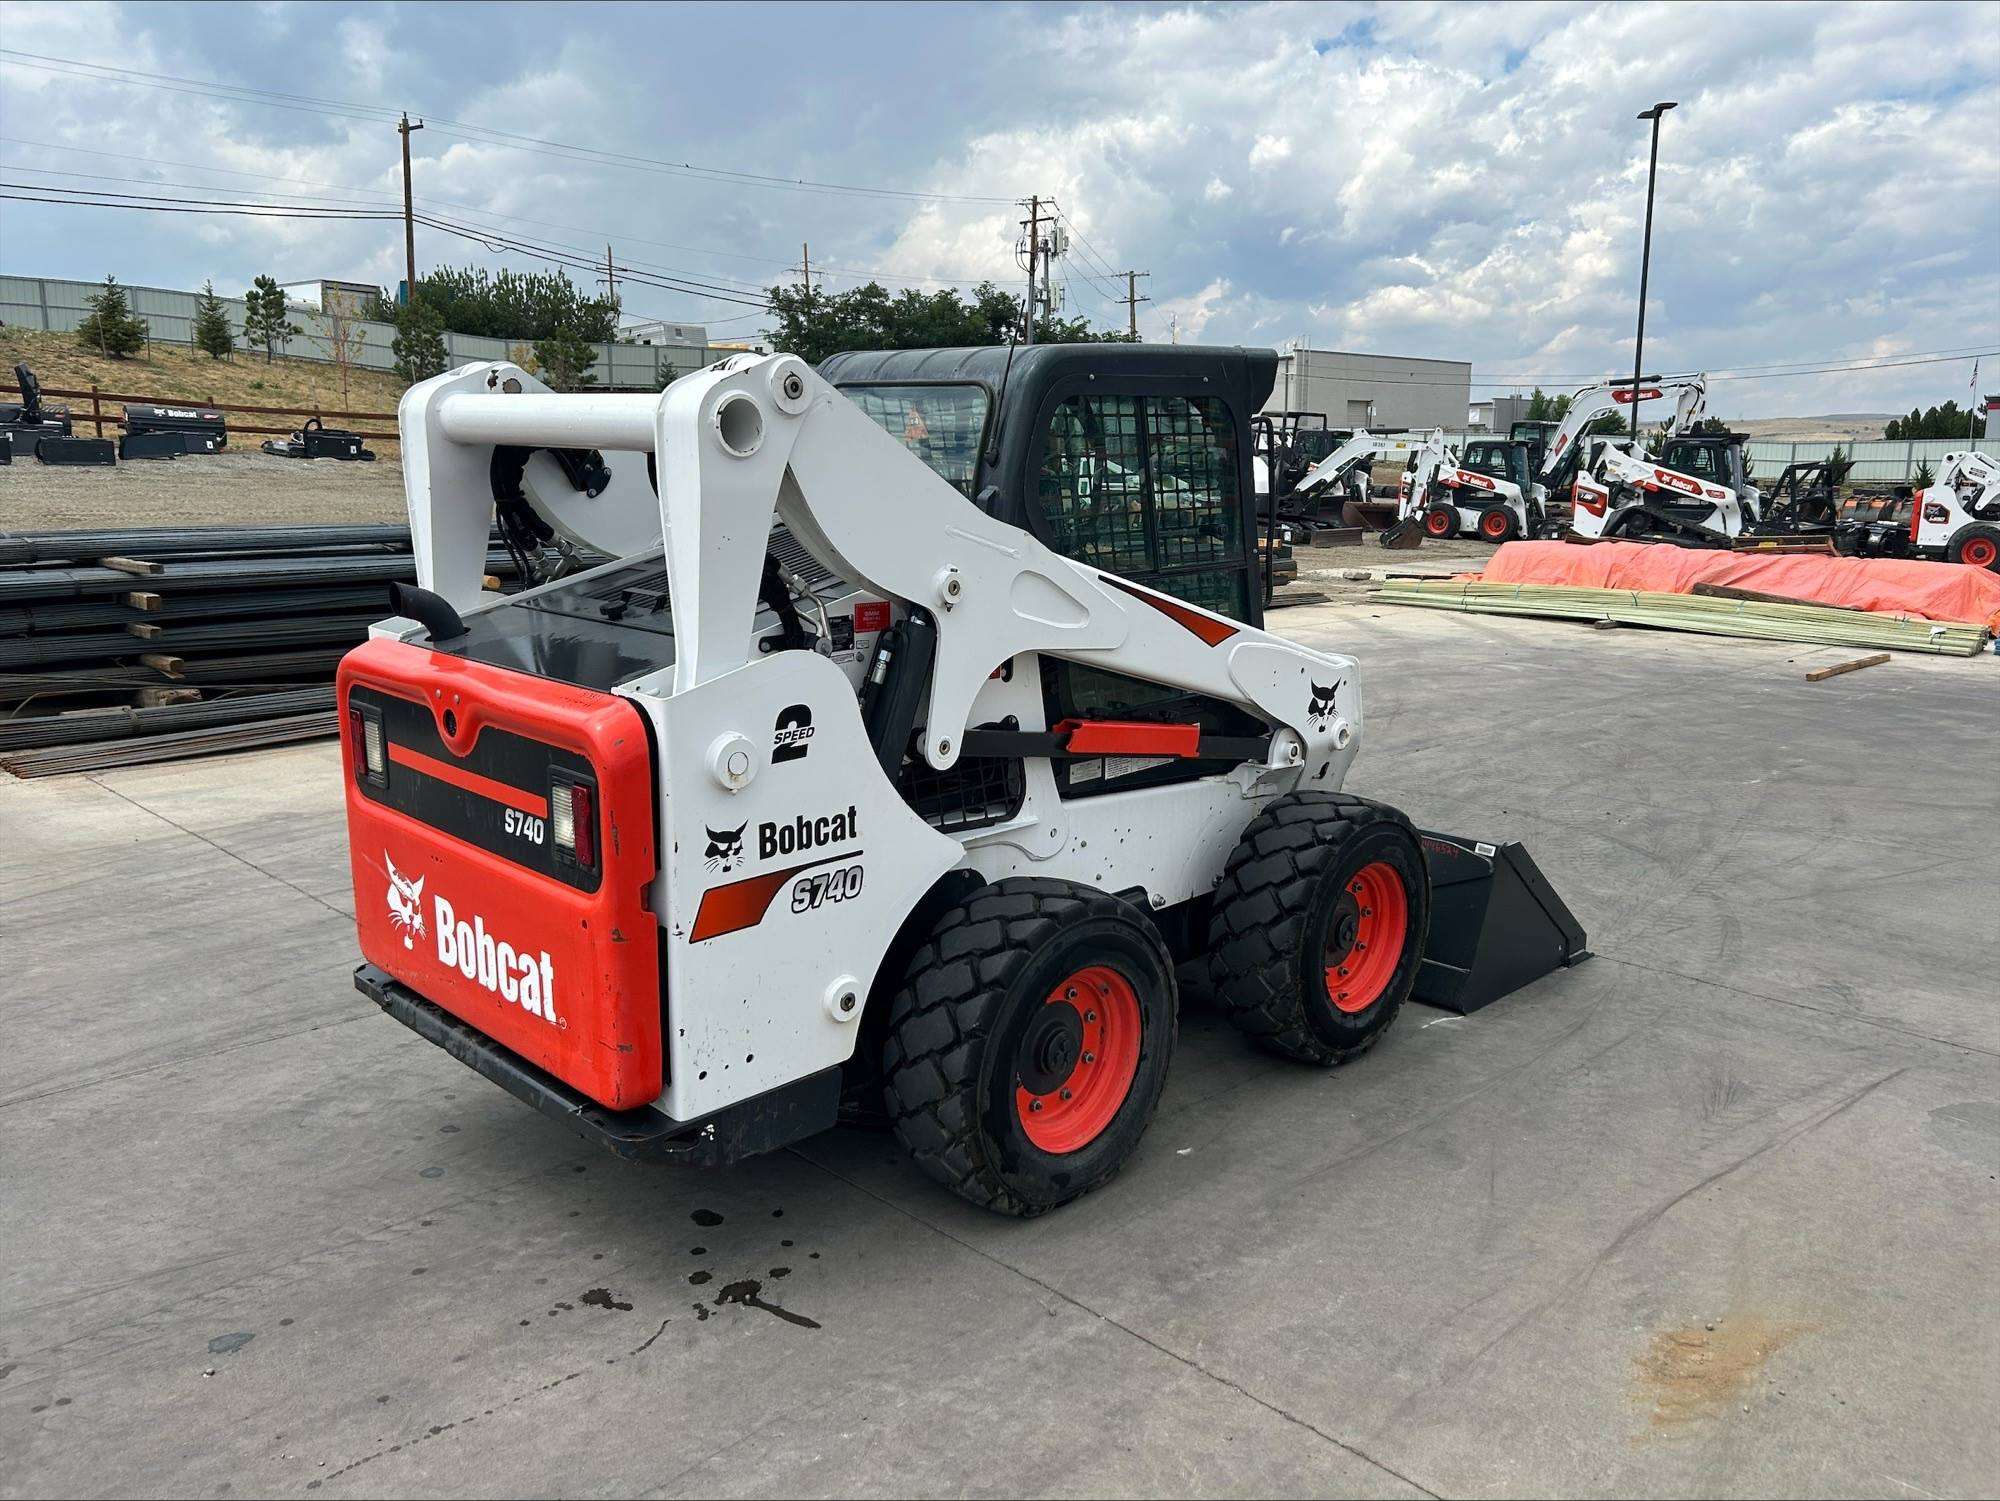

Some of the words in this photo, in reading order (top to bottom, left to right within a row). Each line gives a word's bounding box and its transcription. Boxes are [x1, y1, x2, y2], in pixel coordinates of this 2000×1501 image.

[167, 409, 197, 418] Bobcat
[1470, 476, 1488, 488] Bobcat
[1670, 478, 1694, 492] Bobcat
[771, 703, 812, 764] 2
[774, 726, 815, 745] SPEED
[505, 808, 544, 845] S740
[759, 805, 857, 860] Bobcat
[791, 865, 863, 914] S740
[434, 894, 557, 1025] Bobcat
